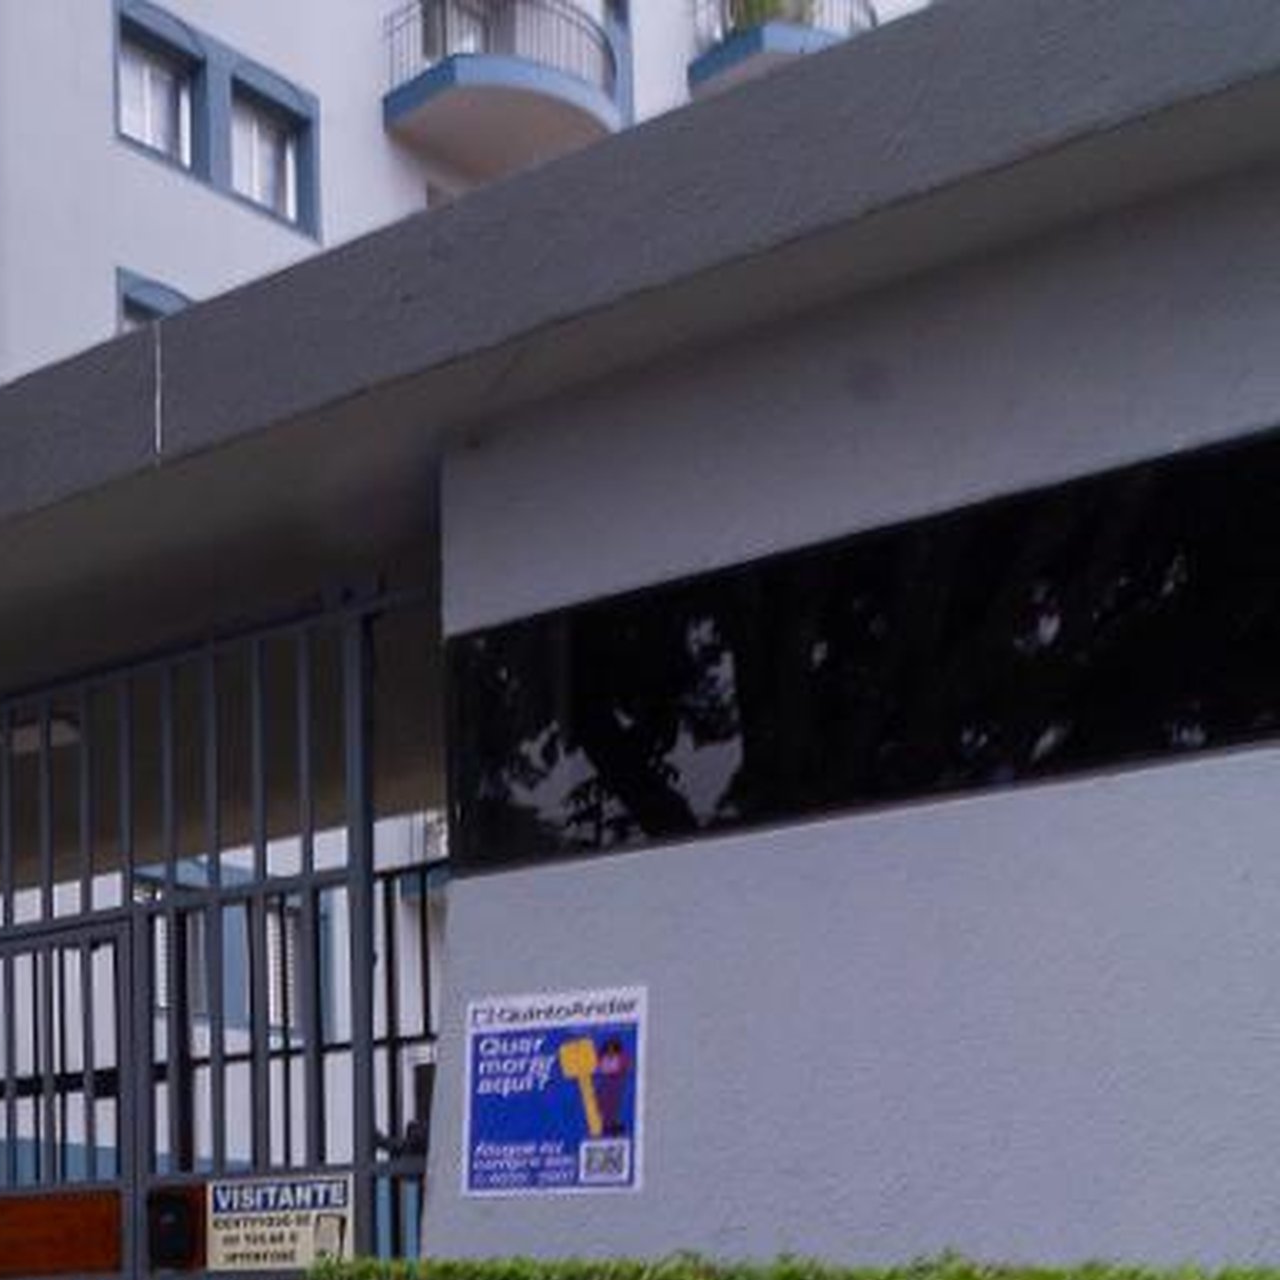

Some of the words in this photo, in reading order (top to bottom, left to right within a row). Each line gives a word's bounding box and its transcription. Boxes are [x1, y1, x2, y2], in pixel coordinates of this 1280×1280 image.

[479, 1036, 543, 1057] Quer
[478, 1055, 556, 1076] morar
[476, 1073, 552, 1098] aqui?
[214, 1182, 345, 1210] VISITANTE
